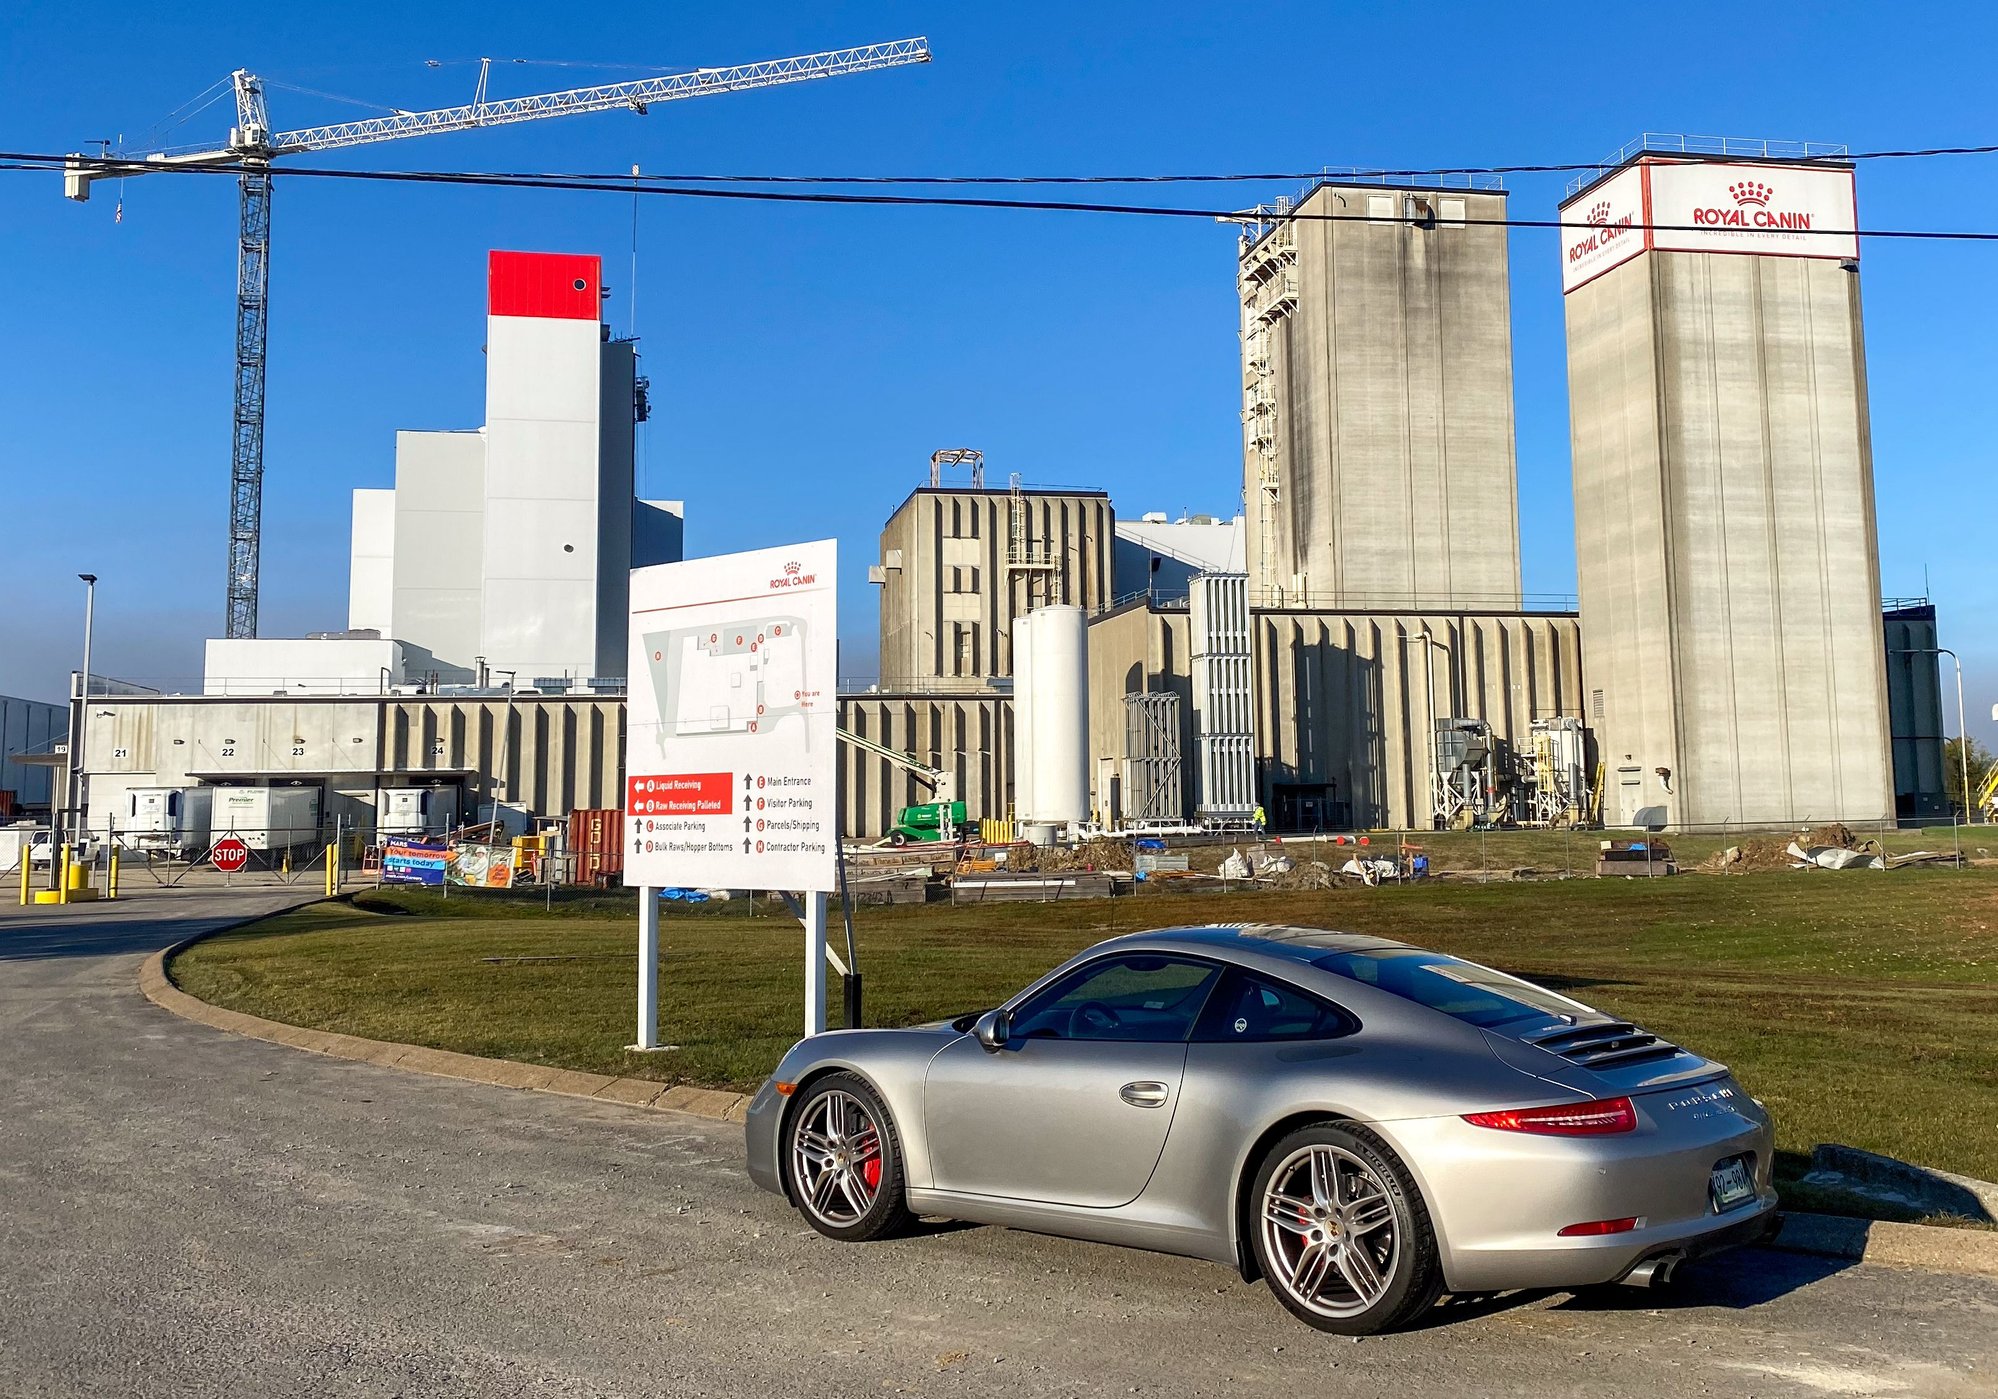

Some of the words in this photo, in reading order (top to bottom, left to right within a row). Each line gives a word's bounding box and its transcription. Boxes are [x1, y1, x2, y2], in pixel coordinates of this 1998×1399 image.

[1693, 208, 1750, 226] ROYAL
[1753, 211, 1811, 229] CANIN
[1569, 234, 1599, 263] ROYAL
[770, 577, 792, 589] ROYAL
[792, 574, 815, 586] CANIN
[114, 749, 126, 757] 21
[221, 748, 235, 757] 22
[292, 747, 305, 756] 23
[431, 746, 444, 755] 24
[656, 781, 673, 792] Liquid
[674, 780, 702, 791] Receiving
[767, 777, 782, 786] Main
[783, 776, 812, 786] Entrance
[655, 801, 668, 810] Raw
[669, 800, 696, 811] Receiving
[767, 798, 787, 808] Visitor
[788, 798, 813, 810] Parking
[655, 821, 682, 831] Associate
[683, 821, 706, 832] Parking
[766, 819, 820, 832] Parcels/Shipping
[390, 840, 408, 848] MARS
[655, 841, 668, 852] Bulk
[668, 841, 708, 853] Raws/Hopper
[708, 841, 733, 852] Bottoms
[766, 841, 800, 852] Contractor
[800, 841, 826, 854] Parking
[214, 848, 245, 862] STOP
[390, 847, 407, 855] Your
[408, 850, 447, 859] tomorrow
[388, 857, 411, 865] starts
[412, 860, 435, 868] today
[1668, 1088, 1734, 1110] PORSCH
[1364, 1149, 1401, 1196] MICHELIN
